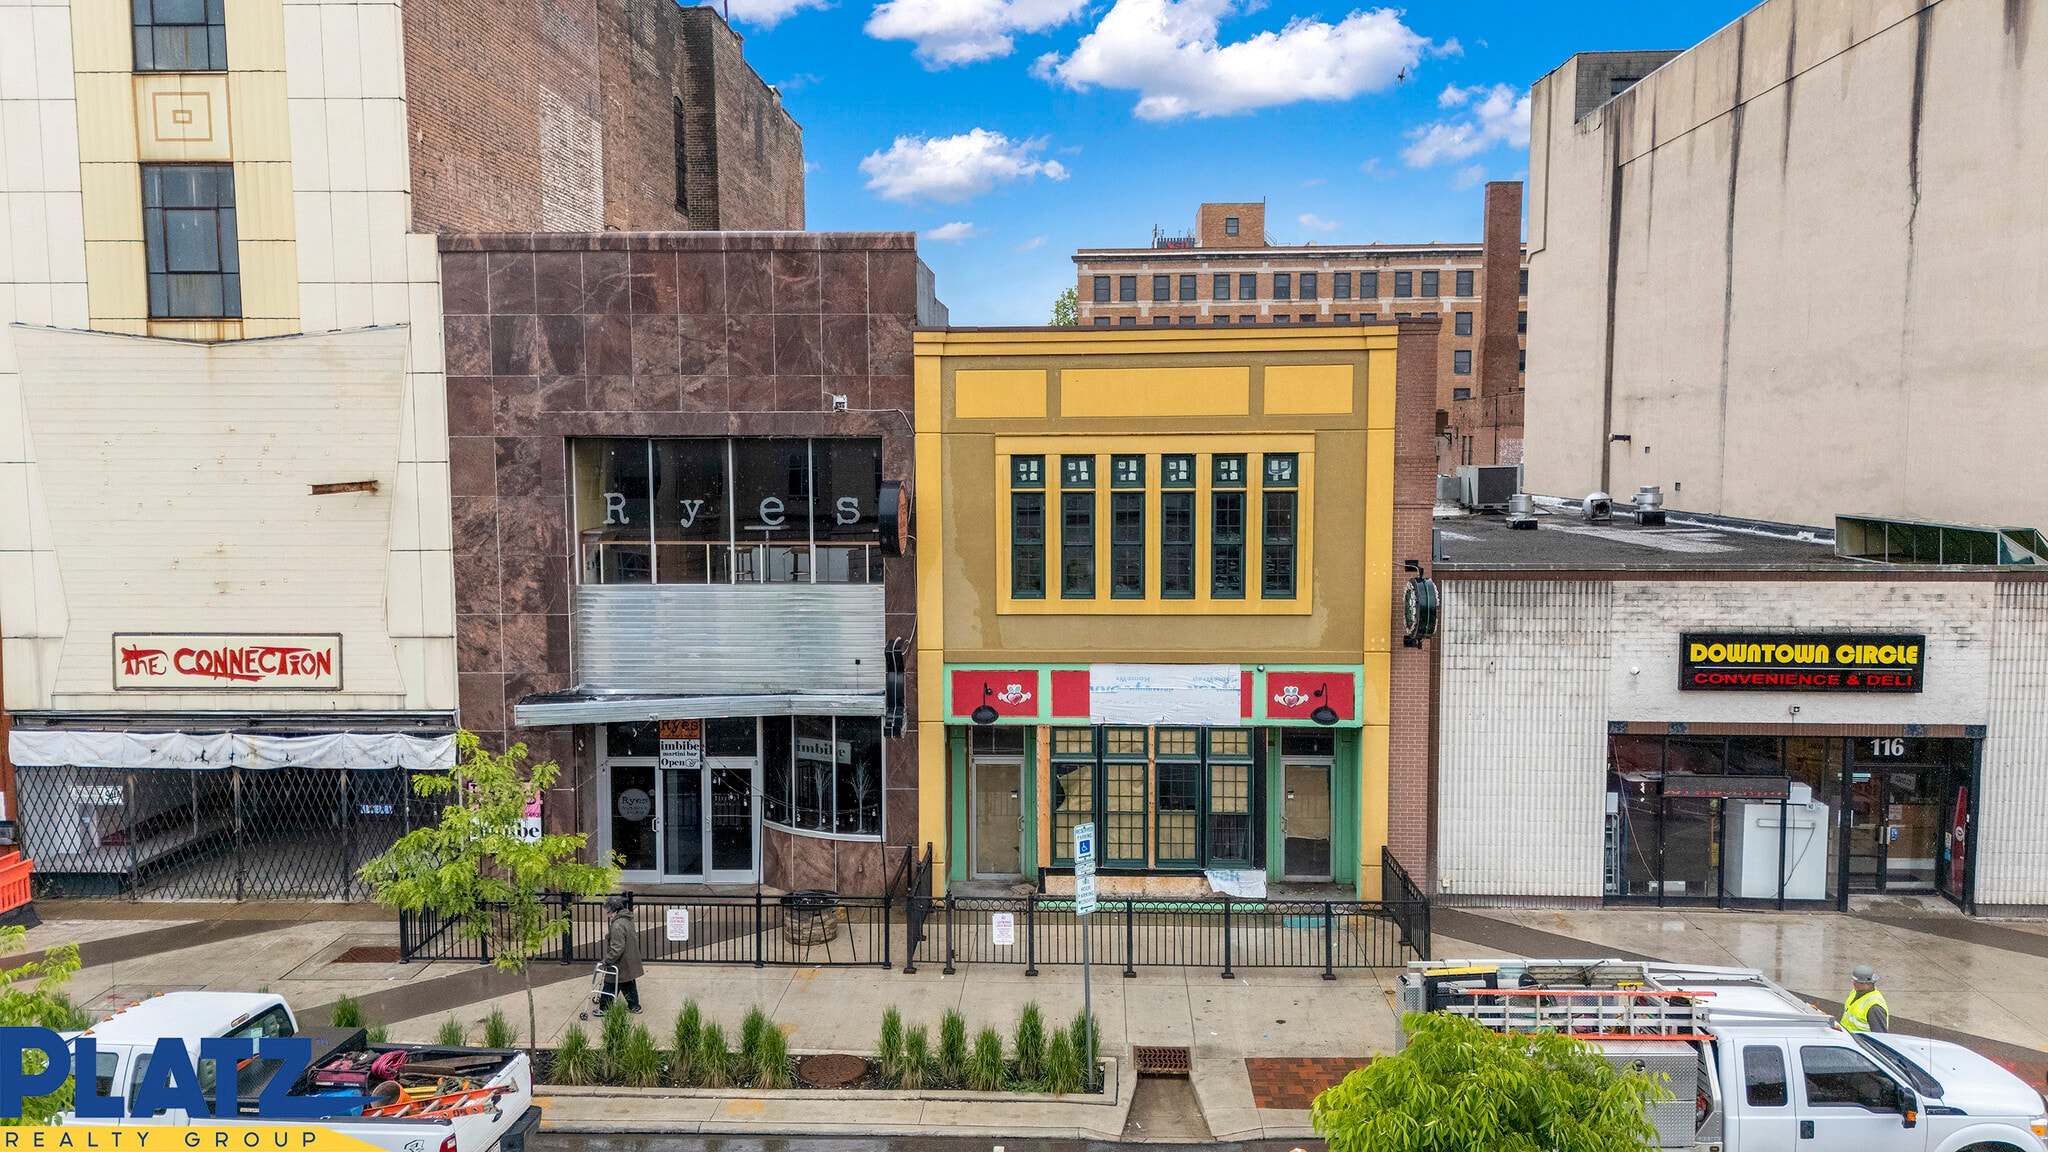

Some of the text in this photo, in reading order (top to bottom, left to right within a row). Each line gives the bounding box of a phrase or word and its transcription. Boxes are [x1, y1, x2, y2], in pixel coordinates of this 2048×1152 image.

[603, 492, 861, 528] Ryes
[1690, 644, 1918, 664] DOWNTOWN CIRCLE
[173, 646, 331, 681] CONNECTION
[1694, 673, 1912, 686] CONVENIENCE & DELI
[661, 720, 699, 734] Ryes
[661, 741, 700, 750] imbibe
[1870, 738, 1904, 756] 116
[661, 758, 685, 767] Open
